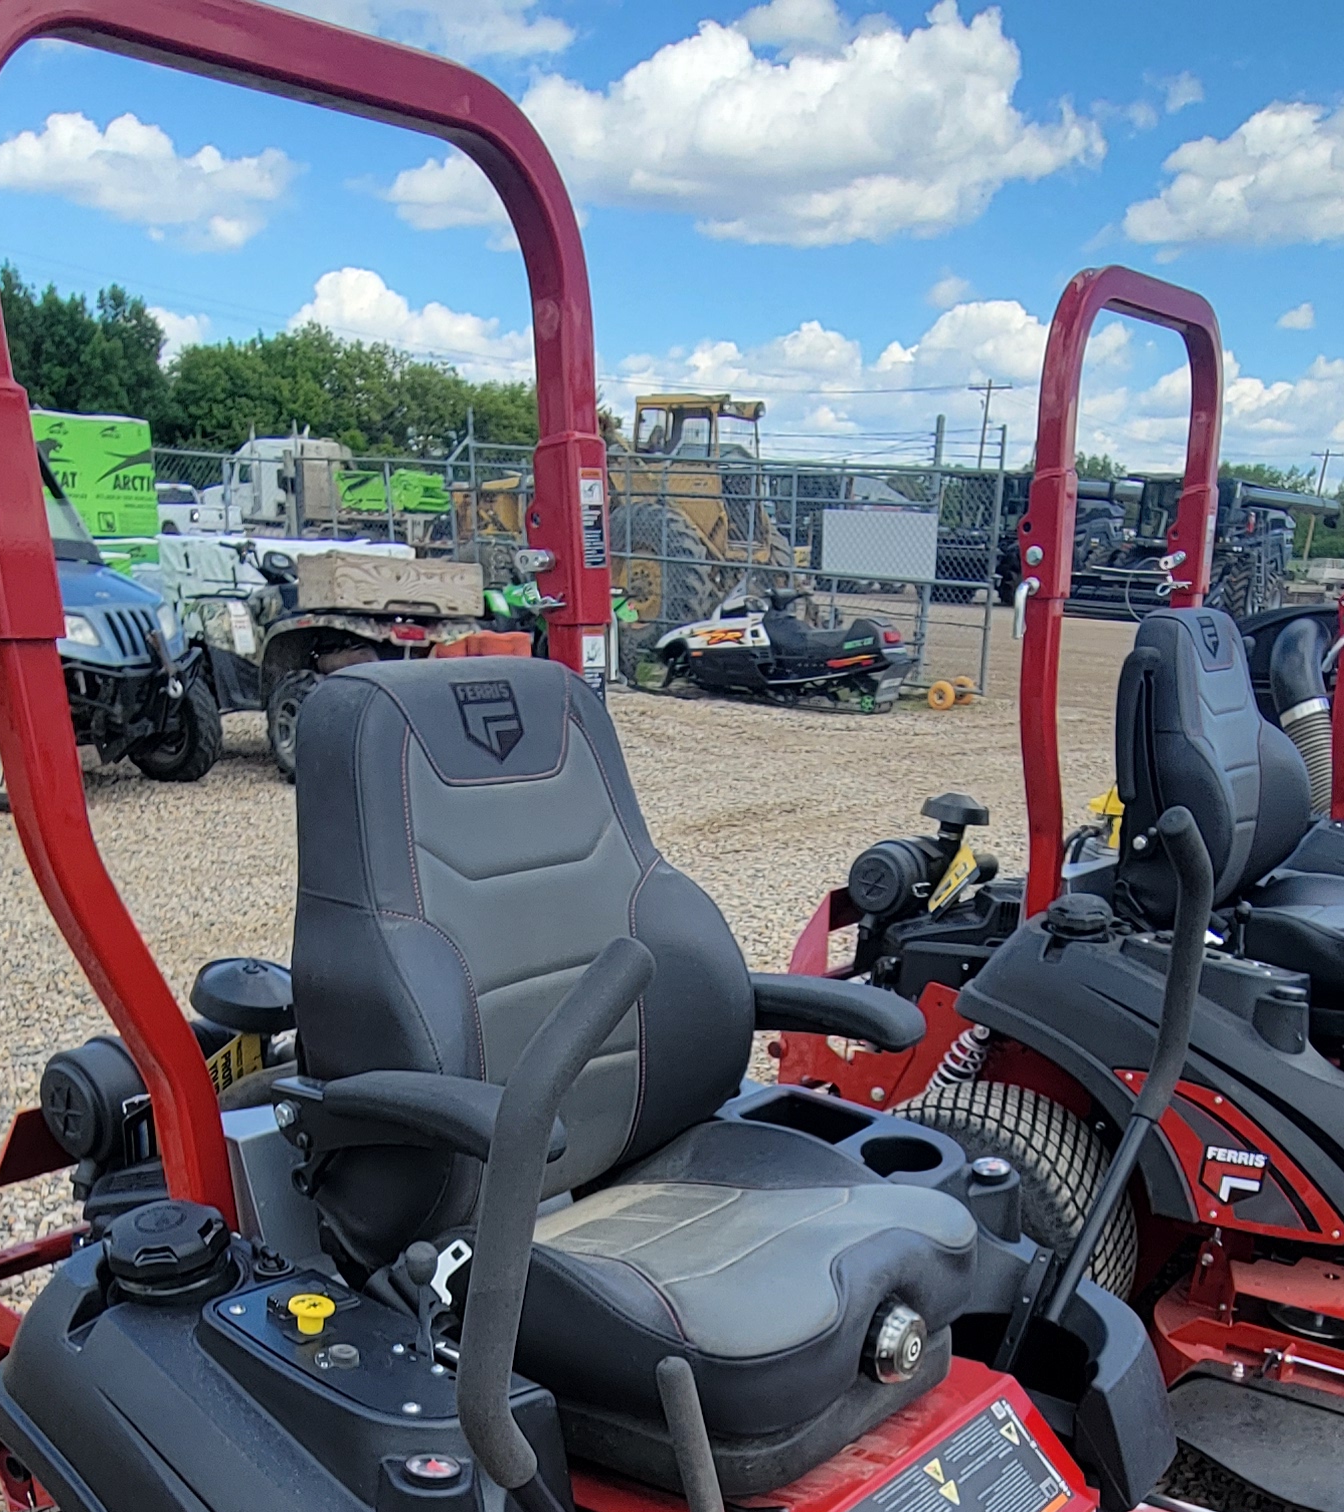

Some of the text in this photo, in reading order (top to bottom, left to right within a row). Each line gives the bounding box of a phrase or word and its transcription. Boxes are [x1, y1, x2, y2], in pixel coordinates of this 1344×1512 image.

[54, 471, 77, 489] AT
[456, 683, 511, 700] FERRIS
[221, 1050, 233, 1091] PROT
[1206, 1146, 1266, 1168] FERRIS
